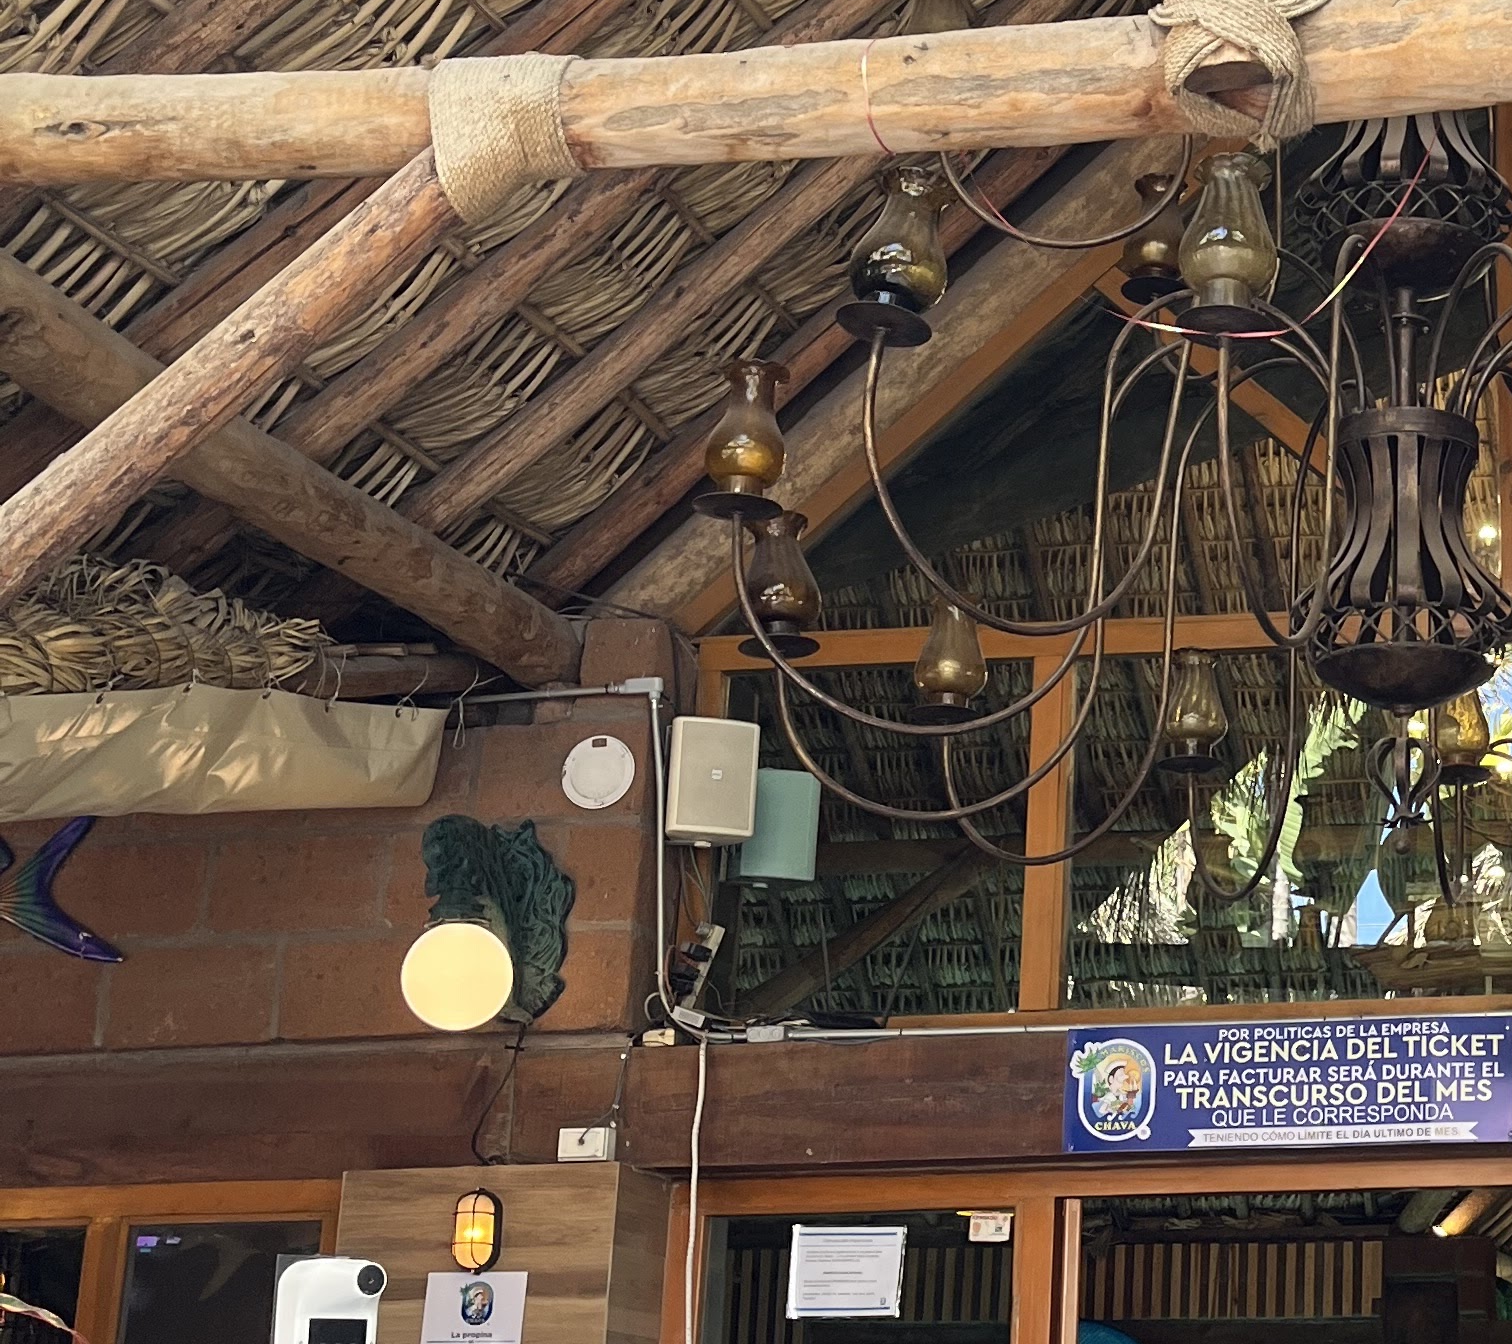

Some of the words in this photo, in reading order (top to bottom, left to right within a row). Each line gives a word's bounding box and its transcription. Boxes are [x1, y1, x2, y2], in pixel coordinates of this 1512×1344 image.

[1218, 1028, 1250, 1042] POR
[1335, 1024, 1356, 1038] DE
[1359, 1023, 1378, 1037] LA
[1381, 1021, 1450, 1036] EMPRESA
[1164, 1043, 1198, 1065] LA
[1203, 1038, 1339, 1064] VIGENCIA
[1346, 1036, 1398, 1061] DEL
[1401, 1033, 1505, 1058] TICKET
[1163, 1070, 1214, 1087] PARA
[1218, 1066, 1322, 1086] FACTURAR
[1327, 1059, 1377, 1082] SERÁ
[1382, 1061, 1476, 1081] DURANTE
[1481, 1061, 1506, 1078] EL
[1175, 1082, 1368, 1109] TRANSCURSO
[1376, 1080, 1429, 1104] DEL
[1436, 1078, 1493, 1102] MES
[1094, 1120, 1137, 1132] CHAVA
[1211, 1108, 1256, 1128] QUE
[1262, 1108, 1287, 1125] LE
[1292, 1103, 1454, 1125] CORRESPONDA
[1203, 1132, 1259, 1143] TENIENDO
[1297, 1129, 1333, 1141] LÍMITE
[1336, 1129, 1349, 1140] EL
[1352, 1129, 1371, 1139] DÍA
[1416, 1127, 1431, 1137] DE
